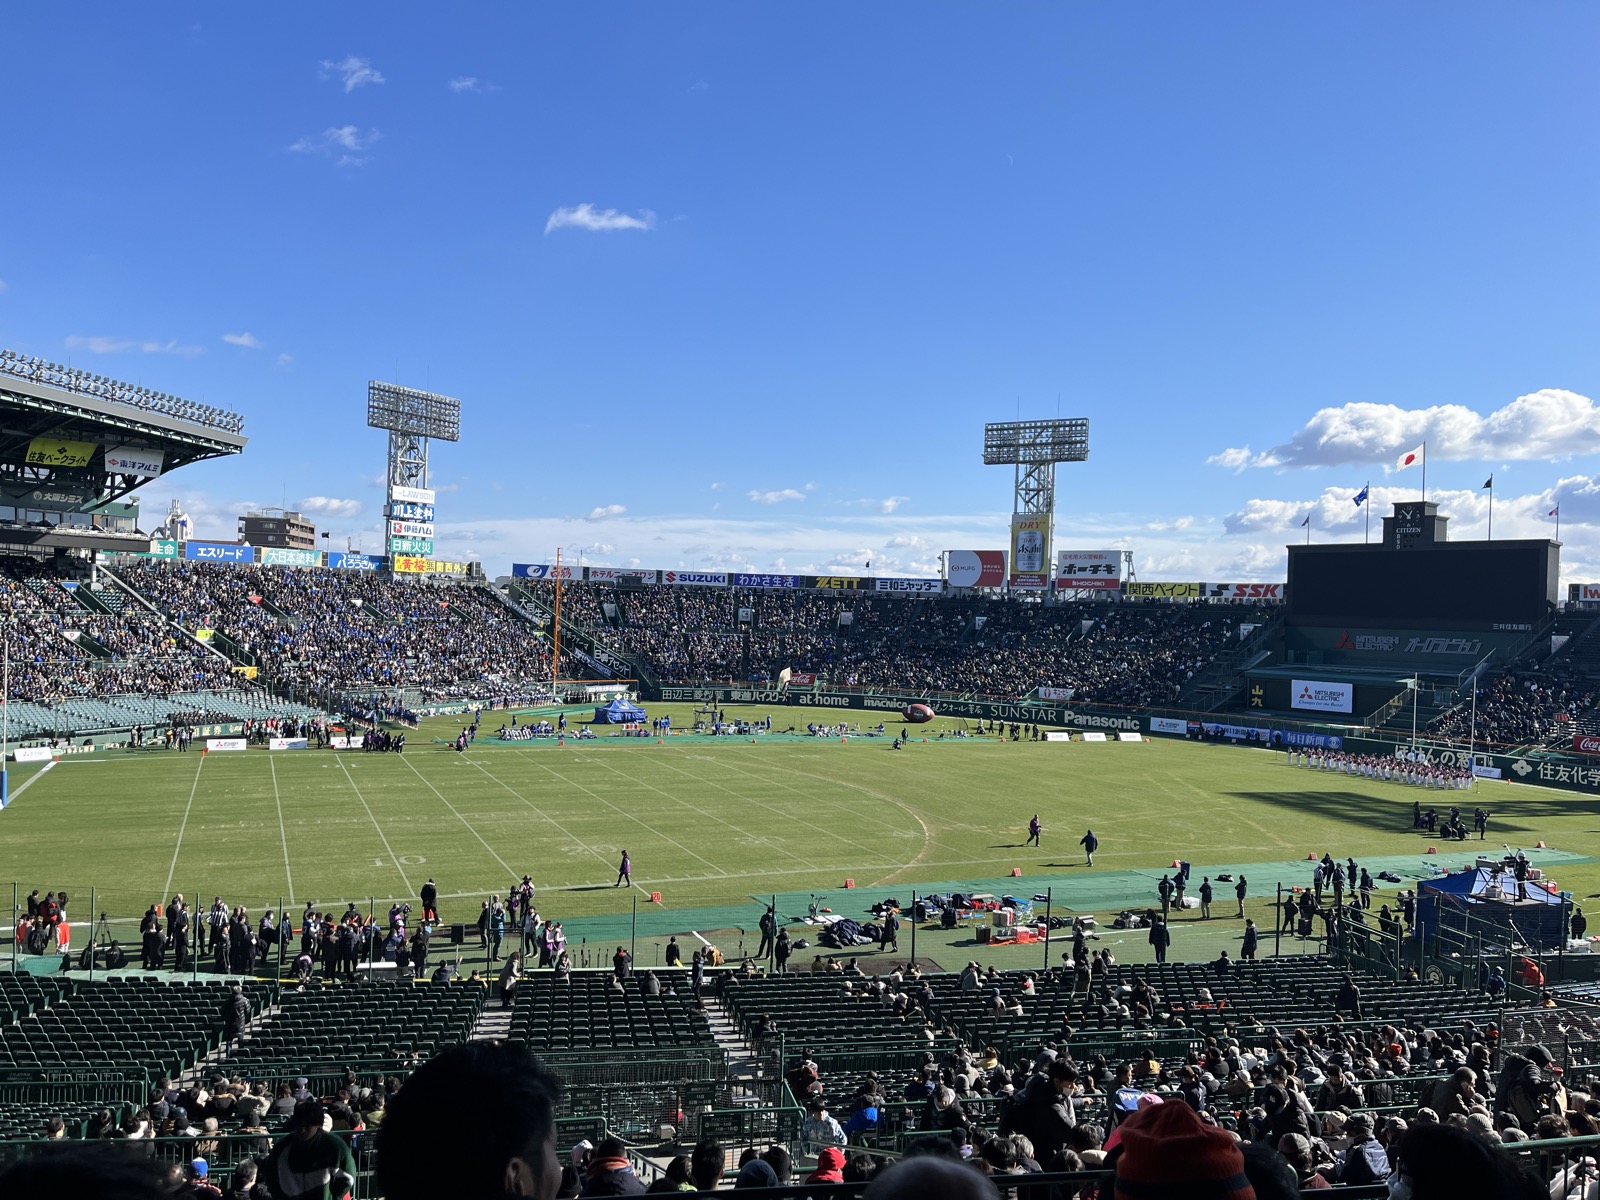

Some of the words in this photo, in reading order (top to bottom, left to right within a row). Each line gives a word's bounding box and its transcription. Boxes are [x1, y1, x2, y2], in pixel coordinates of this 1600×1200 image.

[28, 451, 87, 465] 住友ベークライト
[119, 459, 160, 472] 東洋アルミ
[402, 490, 434, 501] LAWSON
[393, 504, 434, 521] 川上塗料
[403, 524, 433, 535] 伊藤ハム
[393, 540, 432, 553] 日新火災
[1018, 543, 1042, 554] Asahi
[196, 547, 244, 560] エスリード
[268, 551, 315, 564] 大日本塗料
[347, 558, 375, 570] ろうきん
[1062, 563, 1116, 575] ホーチキ
[679, 573, 726, 584] SUZUKI
[739, 574, 794, 588] わかさ生活
[816, 576, 861, 589] ZETT
[879, 580, 938, 592] 三和シャッター
[1128, 583, 1199, 596] 関西ペイント
[1233, 584, 1281, 598] SSK
[519, 597, 552, 625] 大同生命
[561, 628, 589, 650] 住友ファーマ
[1356, 635, 1400, 645] MITSUBISHI
[1356, 643, 1394, 652] ELECTRIC
[799, 695, 813, 705] at
[813, 690, 849, 706] home
[990, 705, 1057, 722] SUNSTAR
[1064, 710, 1141, 731] Panasonic
[1287, 732, 1325, 747] 毎日新聞
